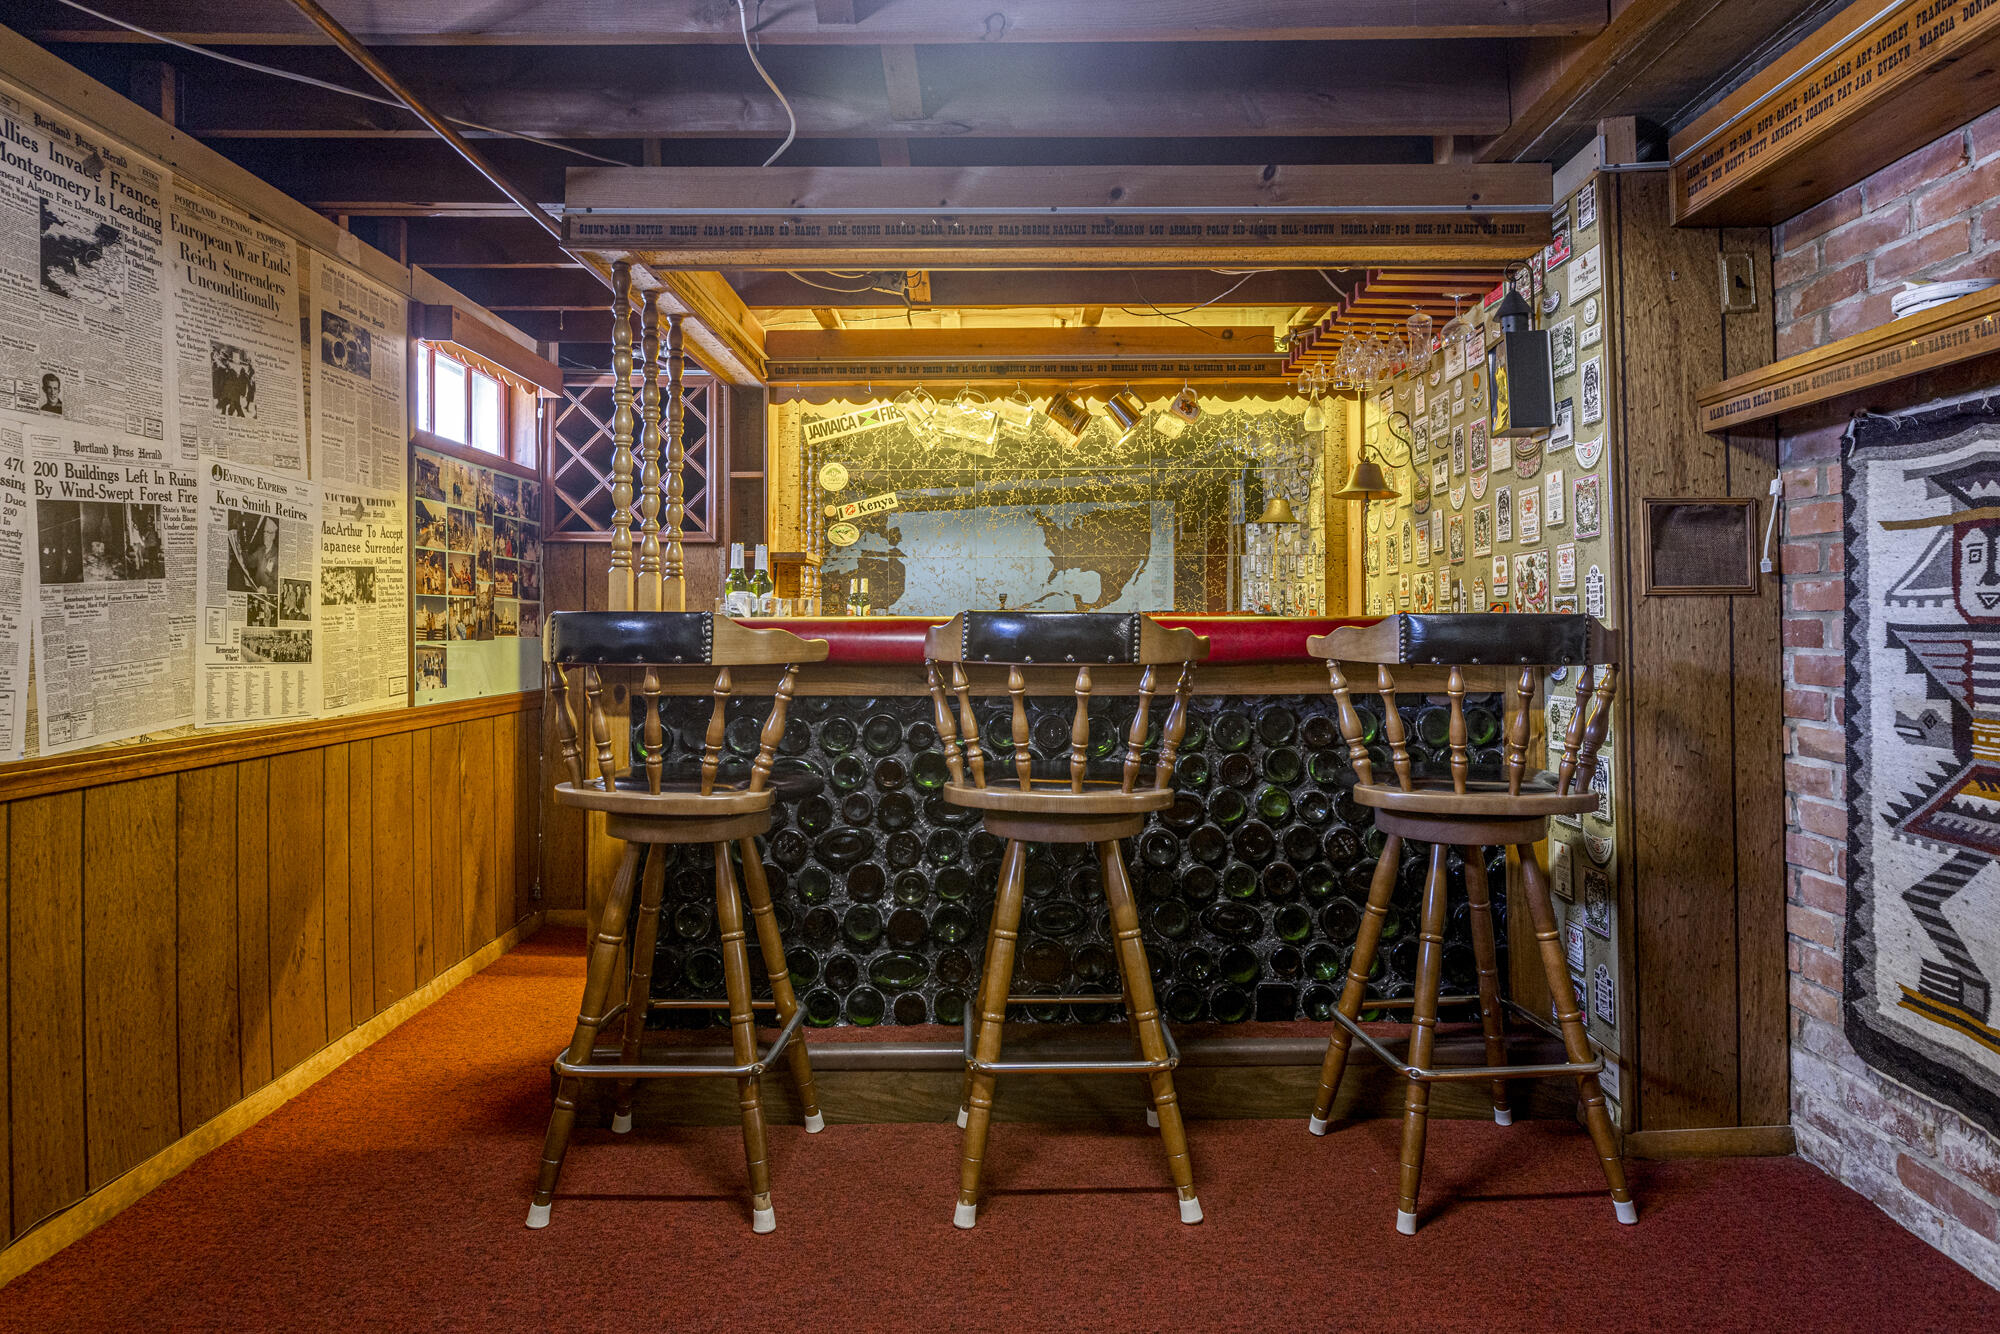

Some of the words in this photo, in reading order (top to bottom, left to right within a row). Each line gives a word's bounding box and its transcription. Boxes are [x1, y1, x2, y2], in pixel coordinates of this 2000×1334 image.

[1770, 114, 1802, 144] ANNETTE
[1805, 94, 1834, 123] JOANNE
[1837, 80, 1852, 102] PAT
[1855, 69, 1872, 91] JAN
[1877, 43, 1910, 76] EVELYN
[1919, 16, 1955, 50] MARCIA
[1962, 0, 1998, 22] DONN
[1776, 98, 1797, 122] GAYLE
[1803, 81, 1820, 104] BILL
[1823, 61, 1851, 90] CLAIRE
[1856, 48, 1873, 69] ART
[1875, 21, 1909, 55] AUDREY
[1916, 0, 1957, 28] FRANC
[34, 112, 71, 140] Portland
[75, 133, 98, 152] Press
[102, 146, 128, 168] Herald
[49, 140, 101, 182] Invae
[27, 180, 54, 199] Alarm
[56, 191, 73, 207] Fire
[75, 200, 106, 222] Destroys
[109, 214, 130, 232] Three
[132, 225, 162, 246] Buildings
[94, 185, 106, 206] Is
[109, 192, 162, 235] Leading
[174, 194, 217, 219] PORTLAND
[221, 215, 253, 235] EVENING
[256, 231, 287, 249] EXPRESS
[670, 225, 697, 236] MILLIE
[704, 225, 724, 236] JEAN
[969, 225, 993, 235] PATSY
[1206, 225, 1229, 235] POLLY
[1281, 225, 1299, 235] BILL
[1436, 224, 1451, 234] PAT
[169, 213, 232, 254] European
[235, 239, 260, 264] War
[262, 250, 291, 276] Ends!
[179, 241, 217, 272] Reich
[223, 259, 286, 296] Surrenders
[186, 265, 281, 317] Unconditionally
[1709, 406, 1724, 421] ALAN
[1753, 390, 1772, 408] KELLY
[1773, 385, 1791, 401] MIKE
[1793, 379, 1809, 395] PHIL
[807, 414, 857, 440] JAMAICA
[73, 440, 109, 456] Portland
[112, 445, 134, 458] Press
[138, 447, 163, 460] Herald
[0, 474, 26, 494] ssing
[33, 460, 58, 478] 200
[64, 463, 120, 484] Buildings
[125, 468, 149, 485] Left
[154, 470, 165, 485] In
[169, 471, 197, 488] Ruins
[223, 469, 255, 488] EVENING
[257, 477, 288, 495] EXPRESS
[35, 479, 53, 499] By
[59, 480, 134, 503] Wind-Swept
[140, 487, 173, 503] Forest
[178, 489, 198, 504] Fire
[324, 492, 362, 504] VICTORY
[366, 498, 396, 508] EDITION
[3, 506, 17, 517] 200
[163, 514, 181, 522] Woods
[216, 490, 239, 508] Ken
[242, 494, 271, 514] Smith
[275, 500, 308, 521] Retires
[838, 508, 844, 518] I
[857, 497, 895, 514] Kenya
[0, 529, 23, 540] ragedy
[3, 517, 11, 526] In
[163, 522, 180, 530] Under
[181, 522, 198, 531] Contro
[366, 524, 377, 538] To
[380, 526, 404, 541] Accept
[365, 540, 404, 554] Surrender
[215, 646, 239, 654] Remember
